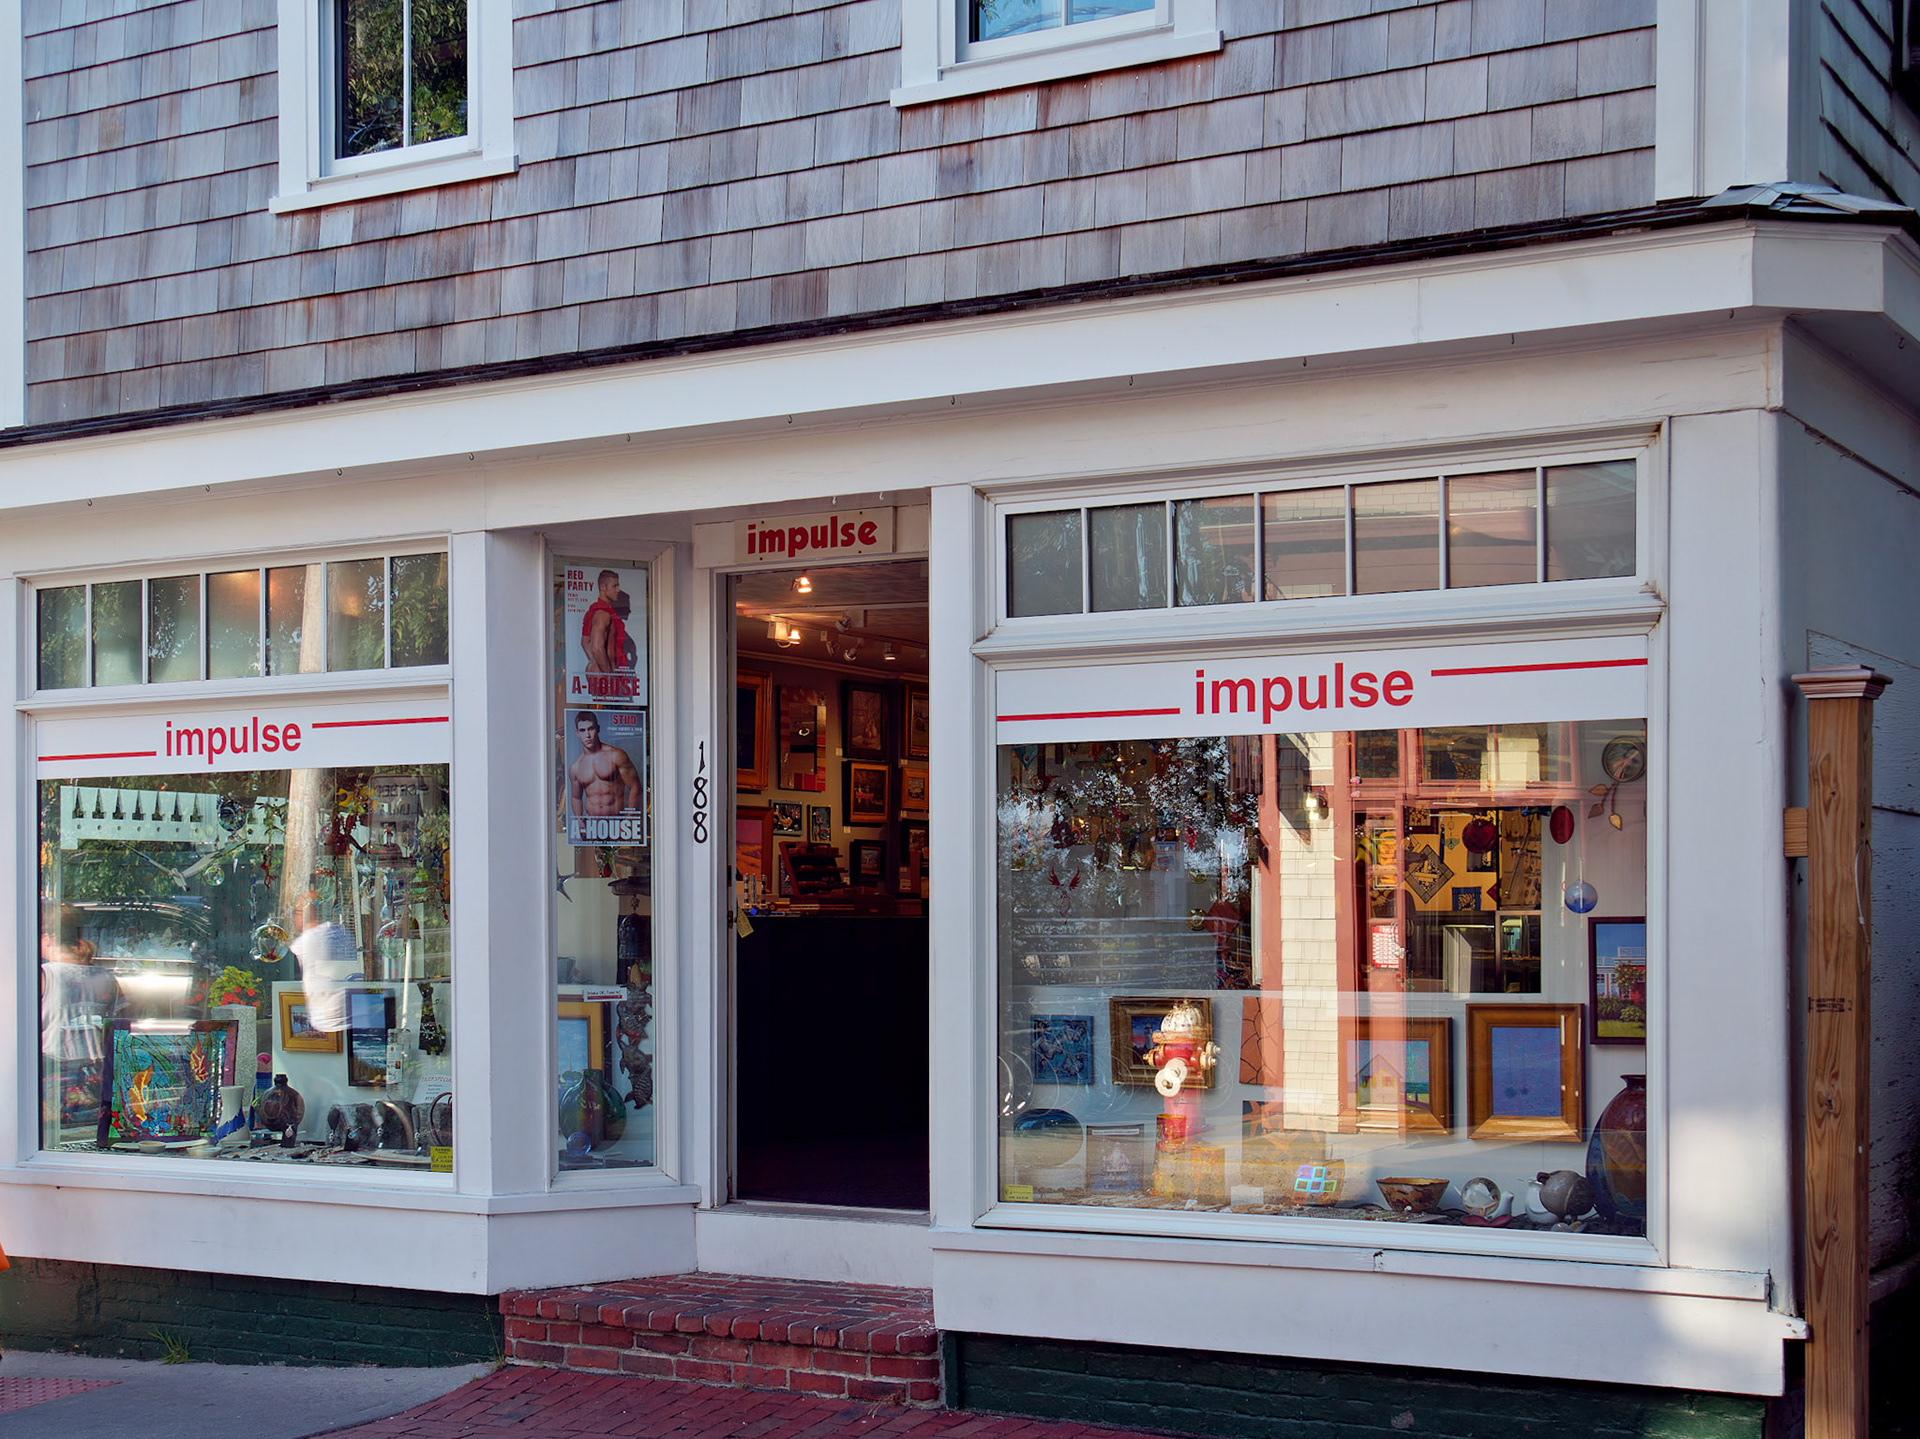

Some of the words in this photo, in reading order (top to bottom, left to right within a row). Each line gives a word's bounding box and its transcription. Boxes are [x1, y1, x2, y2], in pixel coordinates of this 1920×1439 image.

[748, 516, 878, 558] impulse
[567, 570, 584, 580] RED
[567, 581, 594, 592] PARTY
[572, 676, 640, 696] A-HOUSE
[1195, 662, 1414, 724] impulse
[612, 715, 637, 725] STUD
[166, 716, 301, 765] impulse
[693, 740, 708, 844] 188
[570, 819, 641, 840] A-HOUSE
